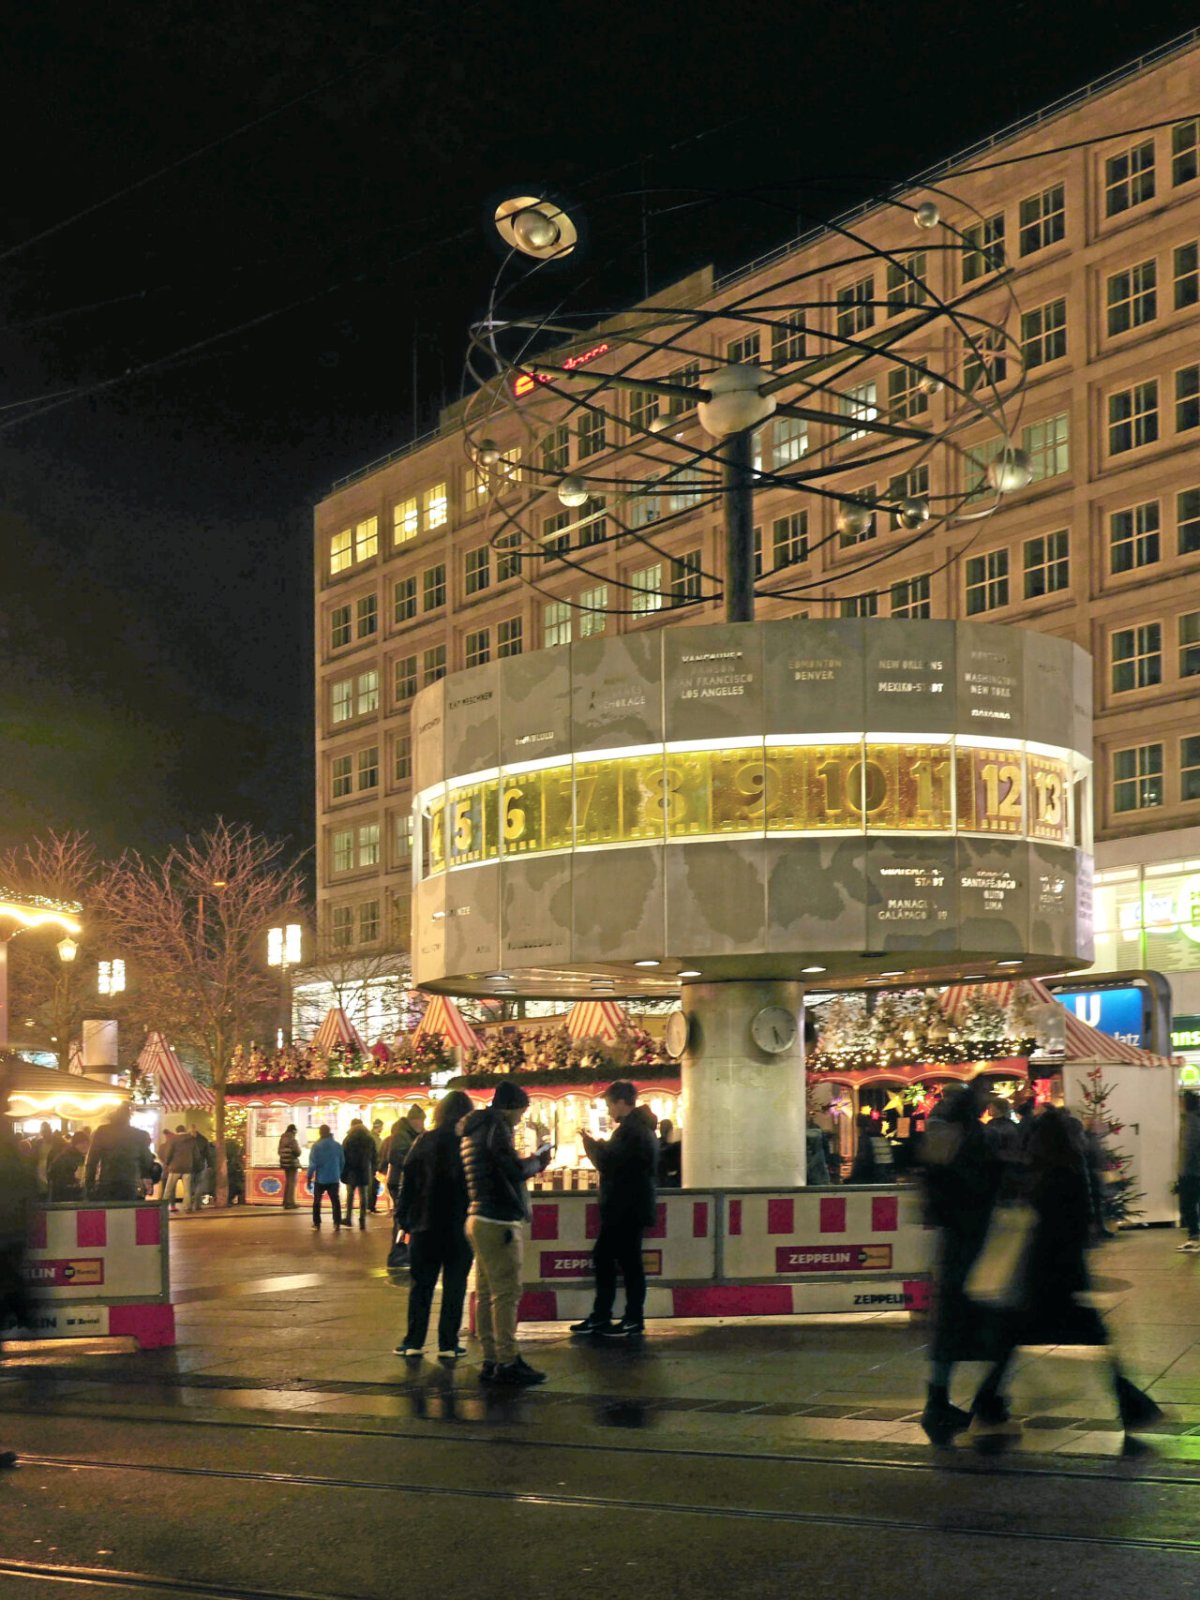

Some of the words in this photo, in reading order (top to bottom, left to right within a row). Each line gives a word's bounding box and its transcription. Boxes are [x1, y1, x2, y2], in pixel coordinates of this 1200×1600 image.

[794, 671, 834, 681] DENVER
[681, 689, 699, 699] LOS
[700, 685, 745, 698] ANGELES
[454, 800, 472, 850] 5
[503, 788, 526, 840] 6
[558, 775, 600, 832] 7
[644, 768, 688, 823] 8
[735, 762, 782, 817] 9
[816, 760, 888, 815] 10
[911, 760, 952, 813] 11
[981, 764, 1024, 817] 12
[1034, 771, 1063, 825] 13
[1075, 995, 1102, 1027] U
[789, 1252, 851, 1264] ZEPPELIN
[853, 1293, 913, 1305] ZEPPELIN
